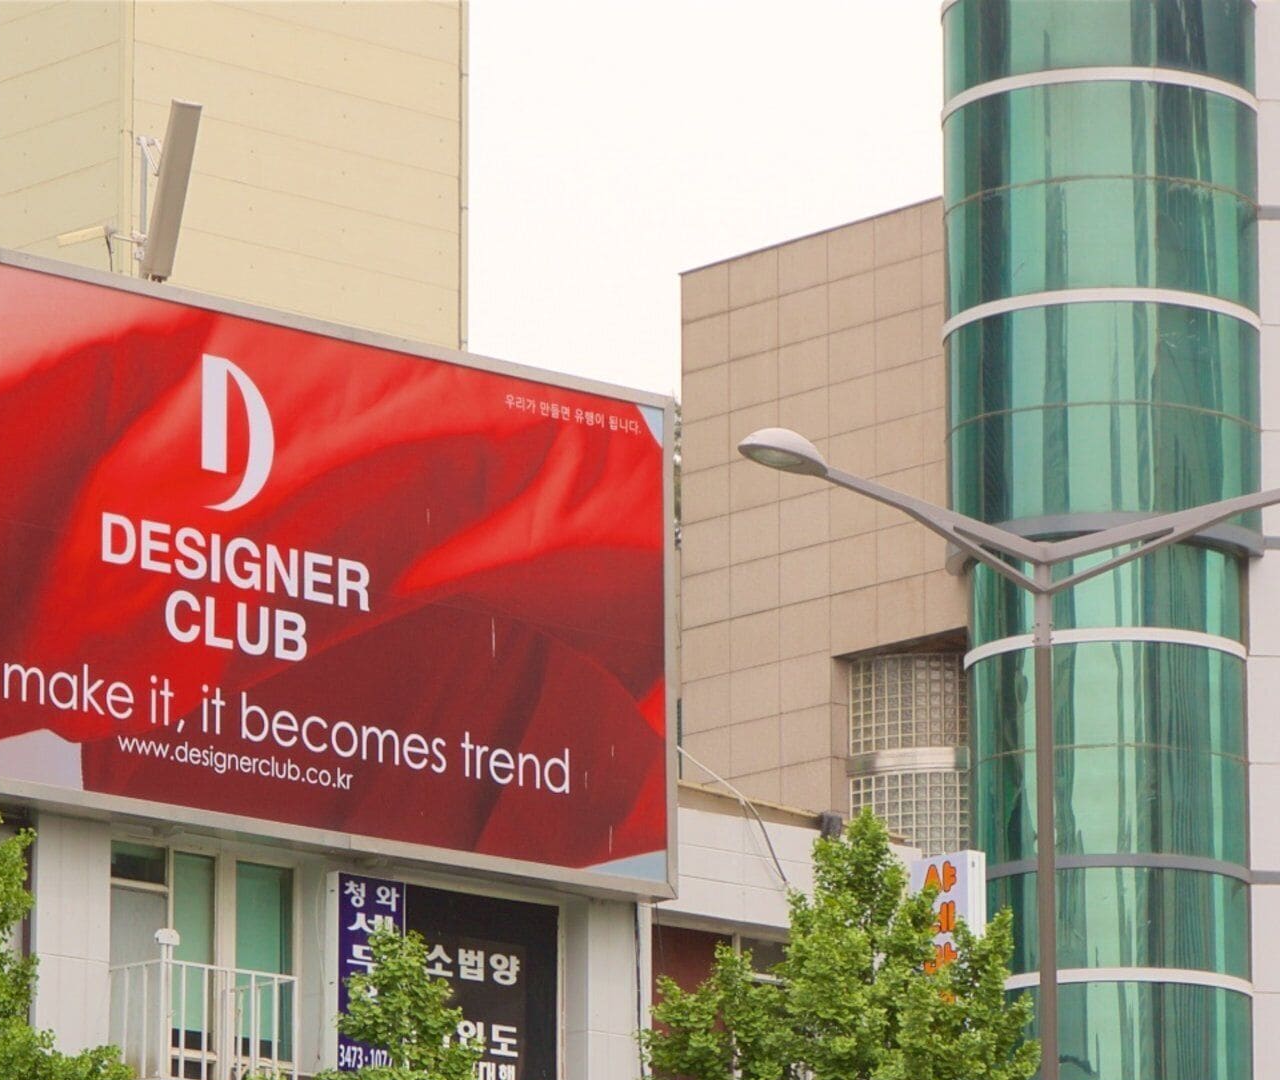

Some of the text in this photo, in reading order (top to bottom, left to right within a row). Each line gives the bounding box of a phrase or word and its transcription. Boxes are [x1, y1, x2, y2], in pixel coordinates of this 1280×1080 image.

[505, 394, 536, 414] 우리가
[539, 401, 570, 421] 만들면
[574, 408, 605, 428] 유행이
[101, 512, 370, 612] DESIGNER
[165, 590, 308, 662] CLUB
[4, 663, 134, 720] make
[150, 675, 185, 733] it,
[202, 684, 226, 735] it
[241, 691, 447, 774] becomes
[461, 731, 571, 795] trend
[118, 735, 353, 790] www.designerclub.co.kr
